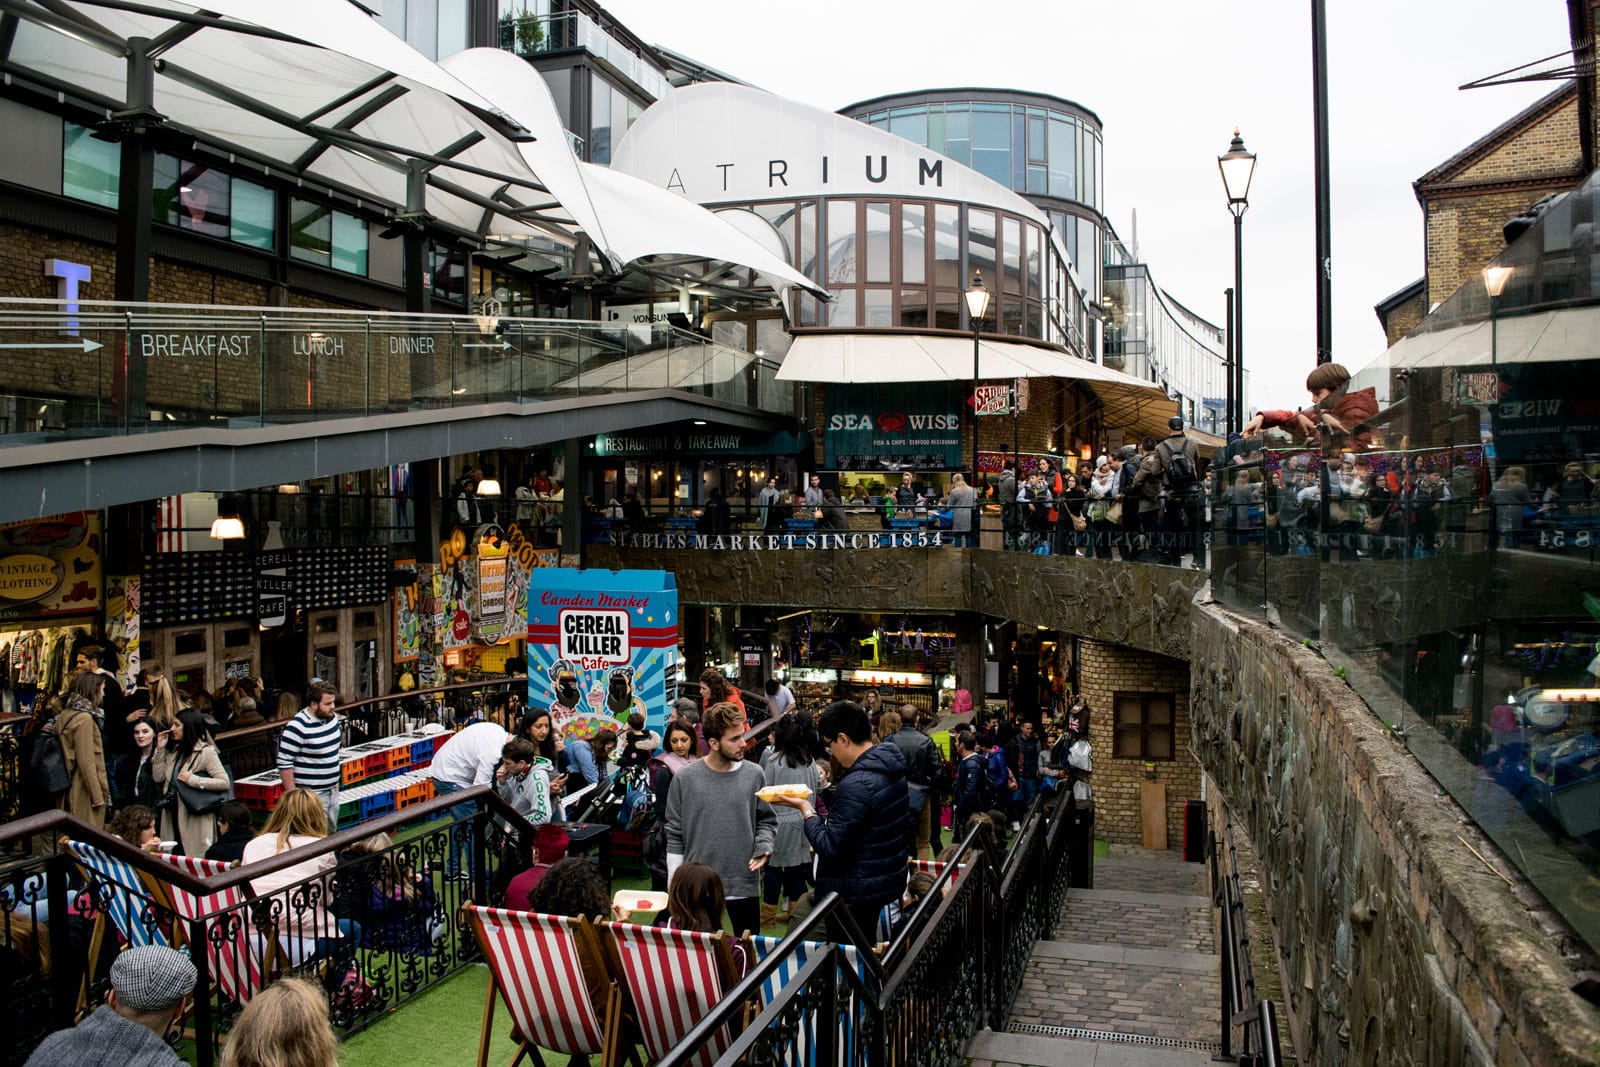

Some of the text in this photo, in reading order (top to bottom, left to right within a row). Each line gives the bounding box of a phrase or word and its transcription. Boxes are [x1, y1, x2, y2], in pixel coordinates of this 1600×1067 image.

[667, 156, 943, 194] ATRIUM
[141, 334, 252, 357] BREAKFAST
[293, 336, 344, 356] LUNCH
[390, 336, 435, 354] DINNER
[988, 399, 1004, 413] ROW
[829, 414, 960, 430] SEA WISE
[605, 434, 740, 452] RESTAURANT & TAKEAWAY
[609, 531, 943, 551] STABLES MARKET SINCE 1854
[255, 553, 293, 567] CEREAL
[256, 579, 293, 591] KILLER
[259, 602, 284, 614] CAFE
[540, 591, 650, 608] Camden Market
[564, 614, 624, 635] CEREAL
[567, 634, 622, 656] KILLER
[581, 656, 610, 671] Cafe
